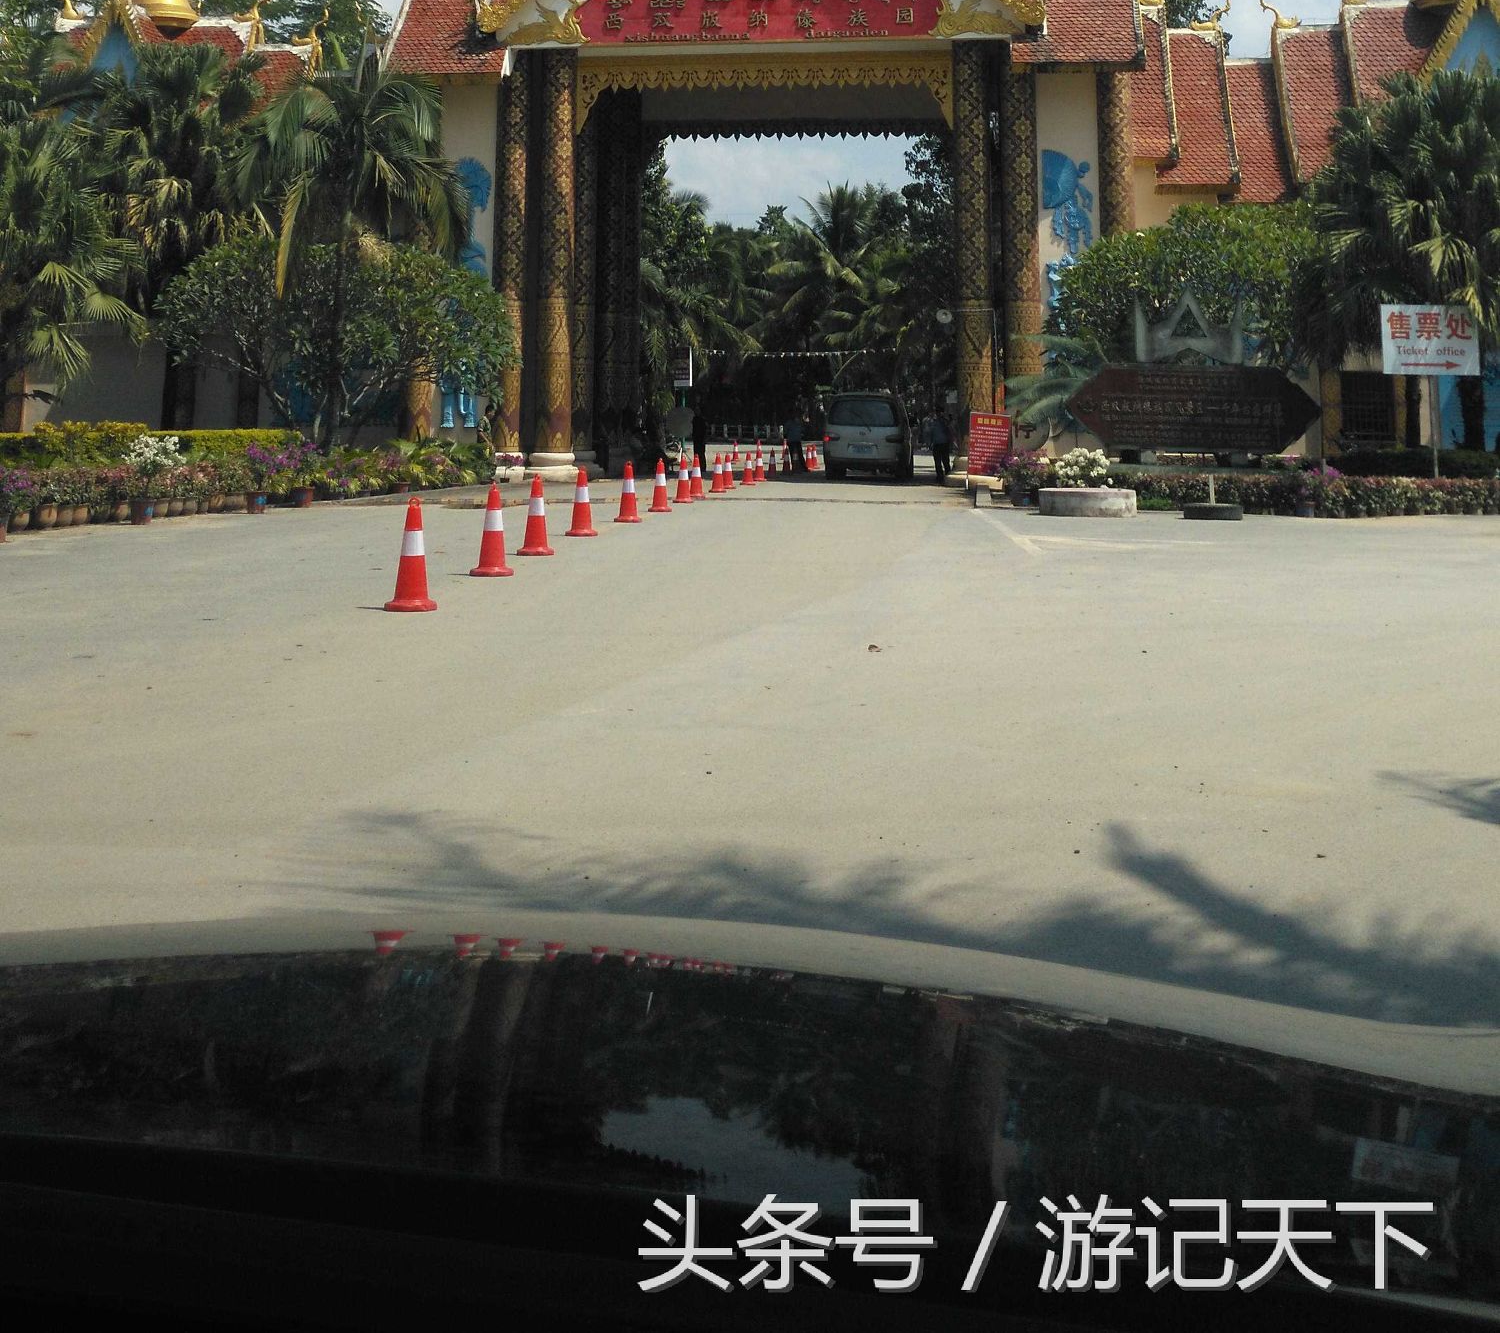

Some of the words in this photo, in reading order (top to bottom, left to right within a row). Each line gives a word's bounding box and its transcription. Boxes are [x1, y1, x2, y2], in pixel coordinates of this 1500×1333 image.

[605, 7, 914, 29] 西双版纳傣族园
[1387, 311, 1472, 340] 售票处
[1396, 345, 1428, 356] Ticket
[1436, 346, 1466, 356] office
